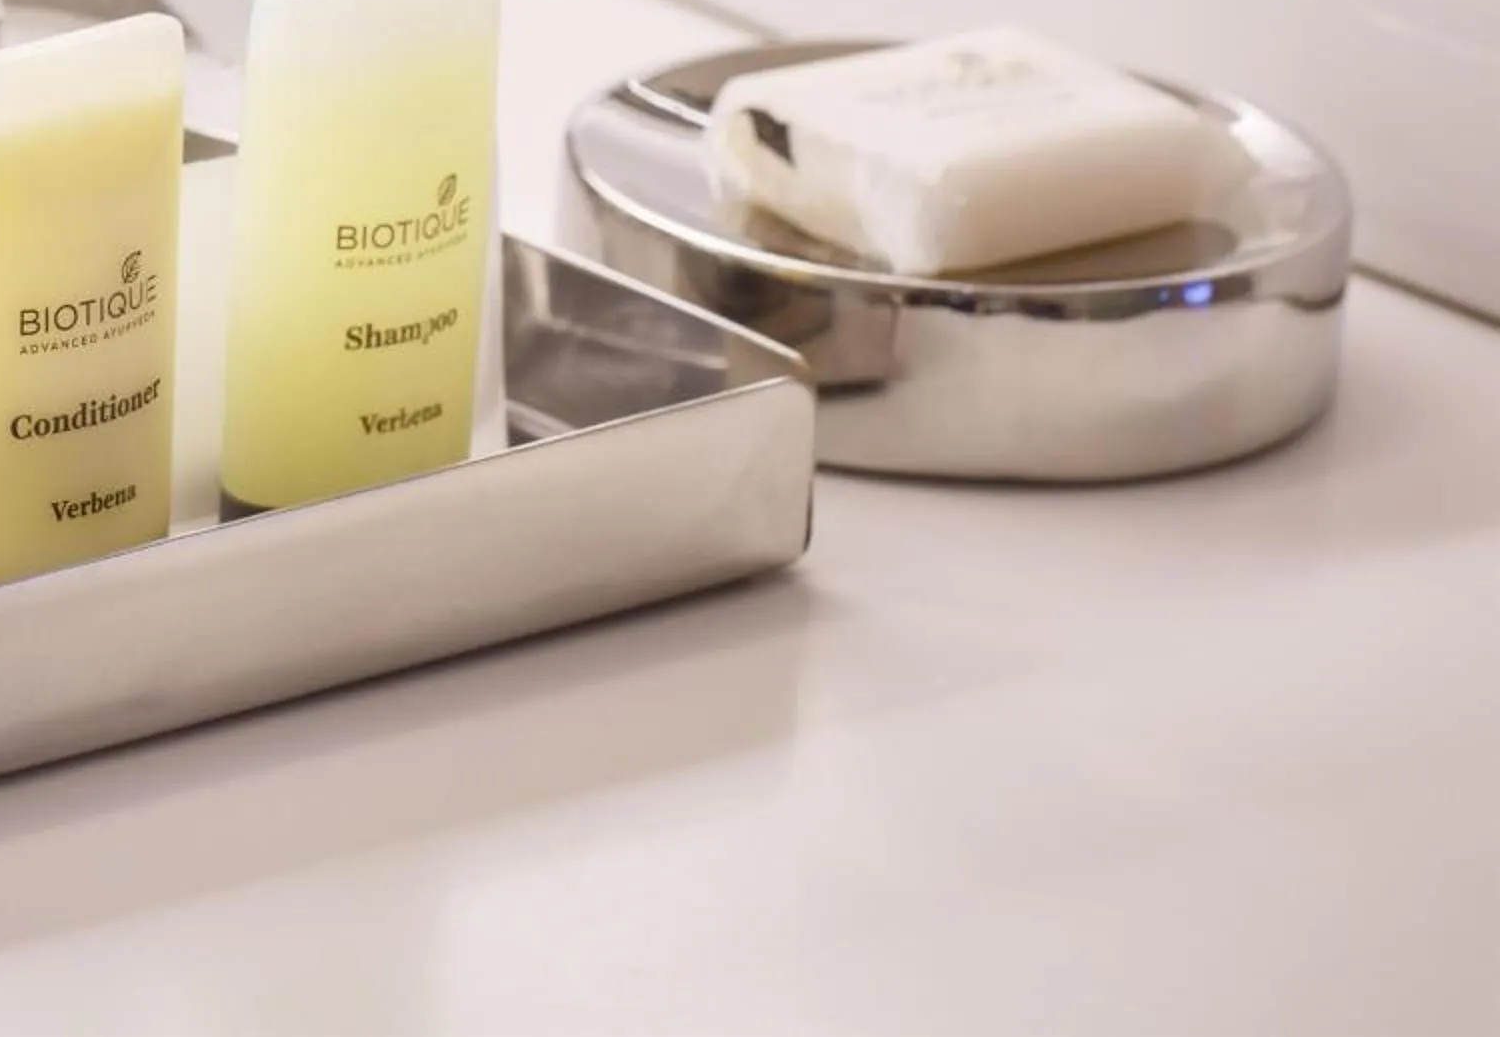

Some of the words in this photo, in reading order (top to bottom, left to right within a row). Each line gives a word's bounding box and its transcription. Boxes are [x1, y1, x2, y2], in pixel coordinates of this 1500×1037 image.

[336, 196, 470, 251] BIOTIQUE
[19, 274, 158, 337] BIOTIQUE
[19, 332, 98, 356] ADVANCED
[9, 377, 161, 441] Conditioner
[51, 484, 137, 522] Verbena
